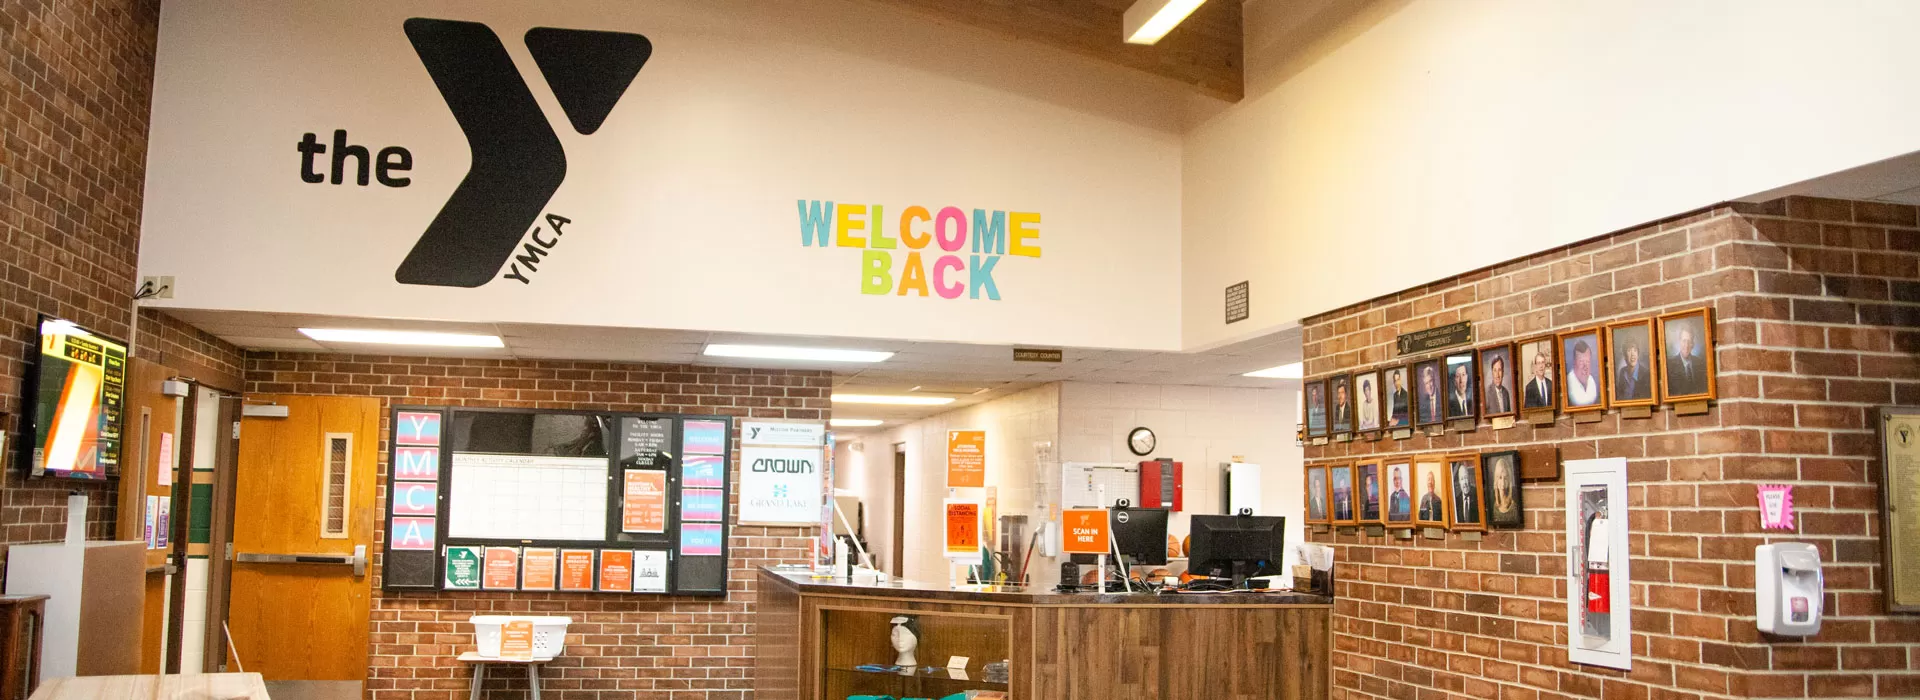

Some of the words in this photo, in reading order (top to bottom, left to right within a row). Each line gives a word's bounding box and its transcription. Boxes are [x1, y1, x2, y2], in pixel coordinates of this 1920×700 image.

[298, 129, 413, 188] the
[503, 212, 572, 285] YMCA
[797, 199, 1042, 258] WELCOME
[861, 249, 1002, 301] BACK
[1073, 527, 1090, 535] SCAN
[1077, 535, 1094, 543] HERE
